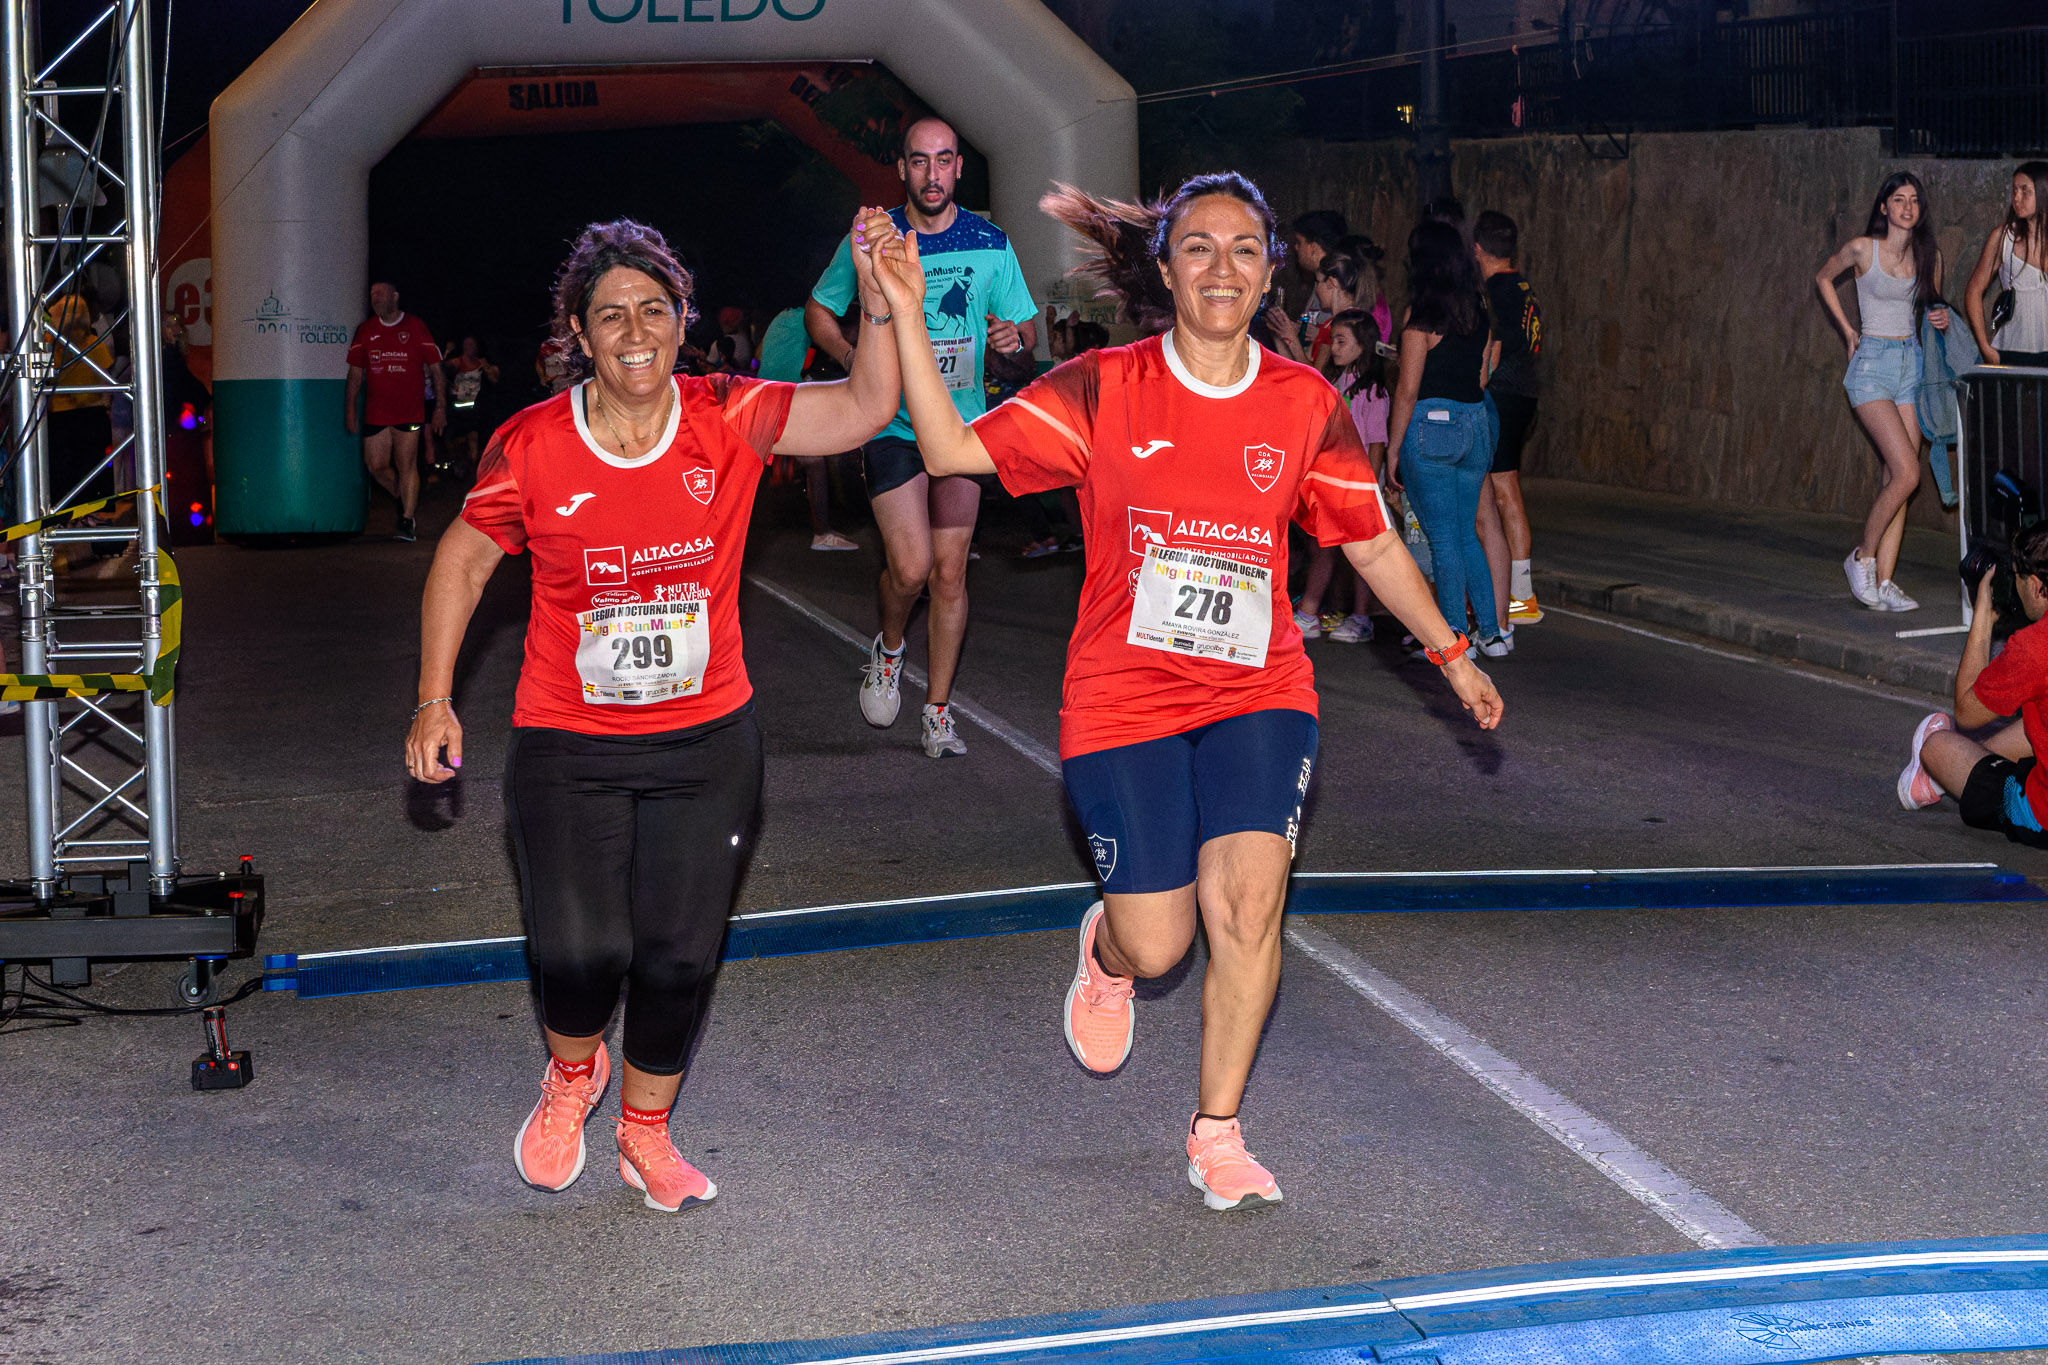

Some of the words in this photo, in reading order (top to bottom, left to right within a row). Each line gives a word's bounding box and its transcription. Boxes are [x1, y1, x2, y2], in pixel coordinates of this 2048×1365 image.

[508, 81, 599, 110] SALIDA
[300, 332, 347, 344] TOLEDO
[1174, 519, 1273, 547] ALTACASA
[631, 535, 715, 564] ALTACASA
[1158, 548, 1188, 564] LEGUA
[1189, 554, 1238, 573] NOCTURNA
[1210, 550, 1269, 564] INMOBILIARIOS
[631, 567, 662, 577] AGENTES
[664, 555, 714, 571] INMOBILIARIOS
[668, 581, 699, 594] NUTRI
[592, 607, 615, 622] LEGUA
[618, 603, 668, 617] NOCTURNA
[669, 602, 700, 614] UGENA
[1174, 584, 1234, 625] 278
[1136, 632, 1165, 643] MULTIdental
[1162, 620, 1182, 629] AMAYA
[1183, 624, 1206, 633] ROVIRA
[612, 634, 673, 671] 299
